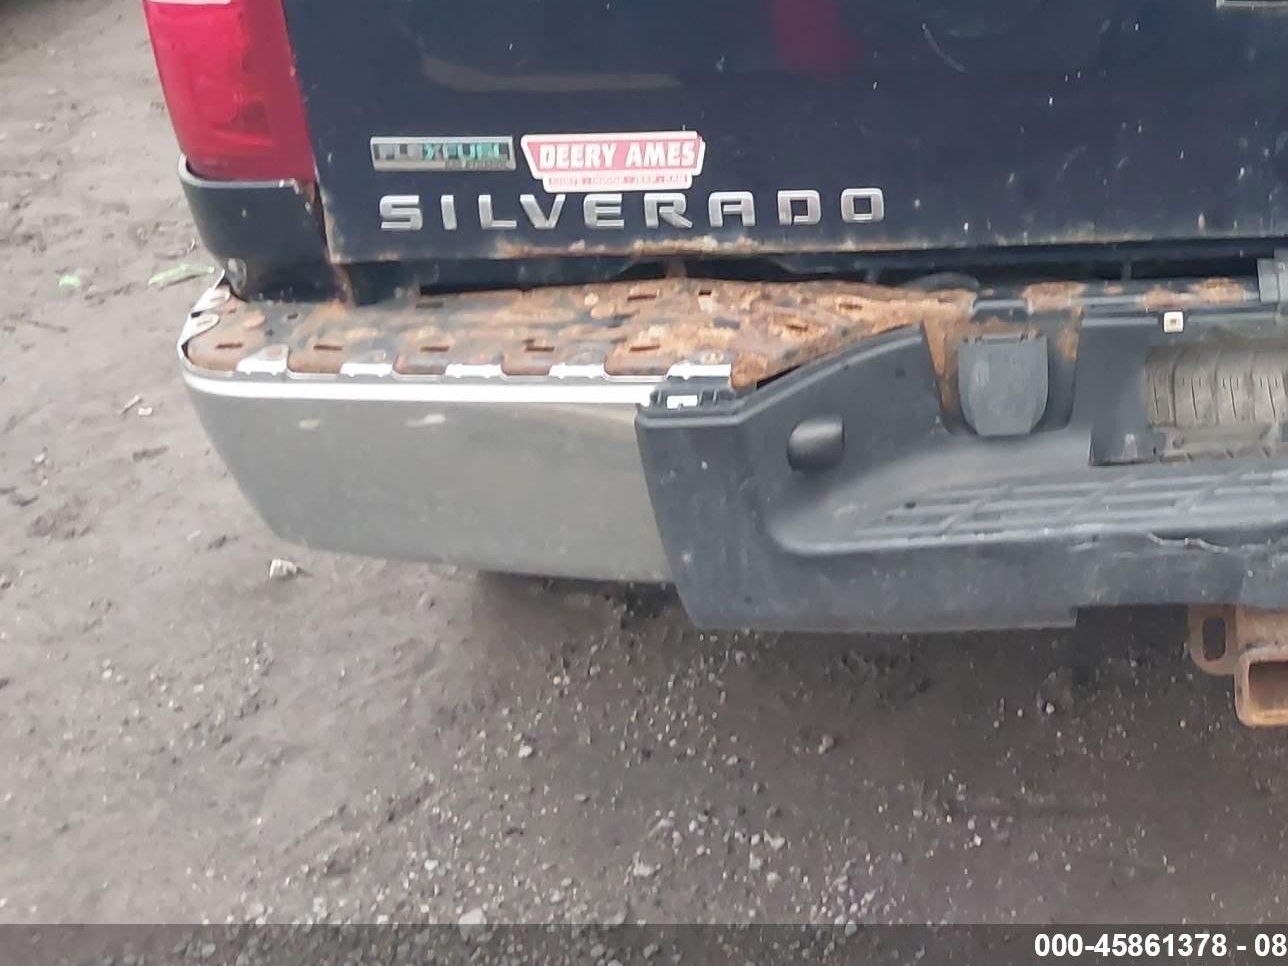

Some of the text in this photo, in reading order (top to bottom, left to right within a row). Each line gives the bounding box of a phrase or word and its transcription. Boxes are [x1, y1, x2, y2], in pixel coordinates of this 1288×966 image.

[539, 141, 696, 170] DEERY AMES
[378, 187, 885, 231] SILVERADO
